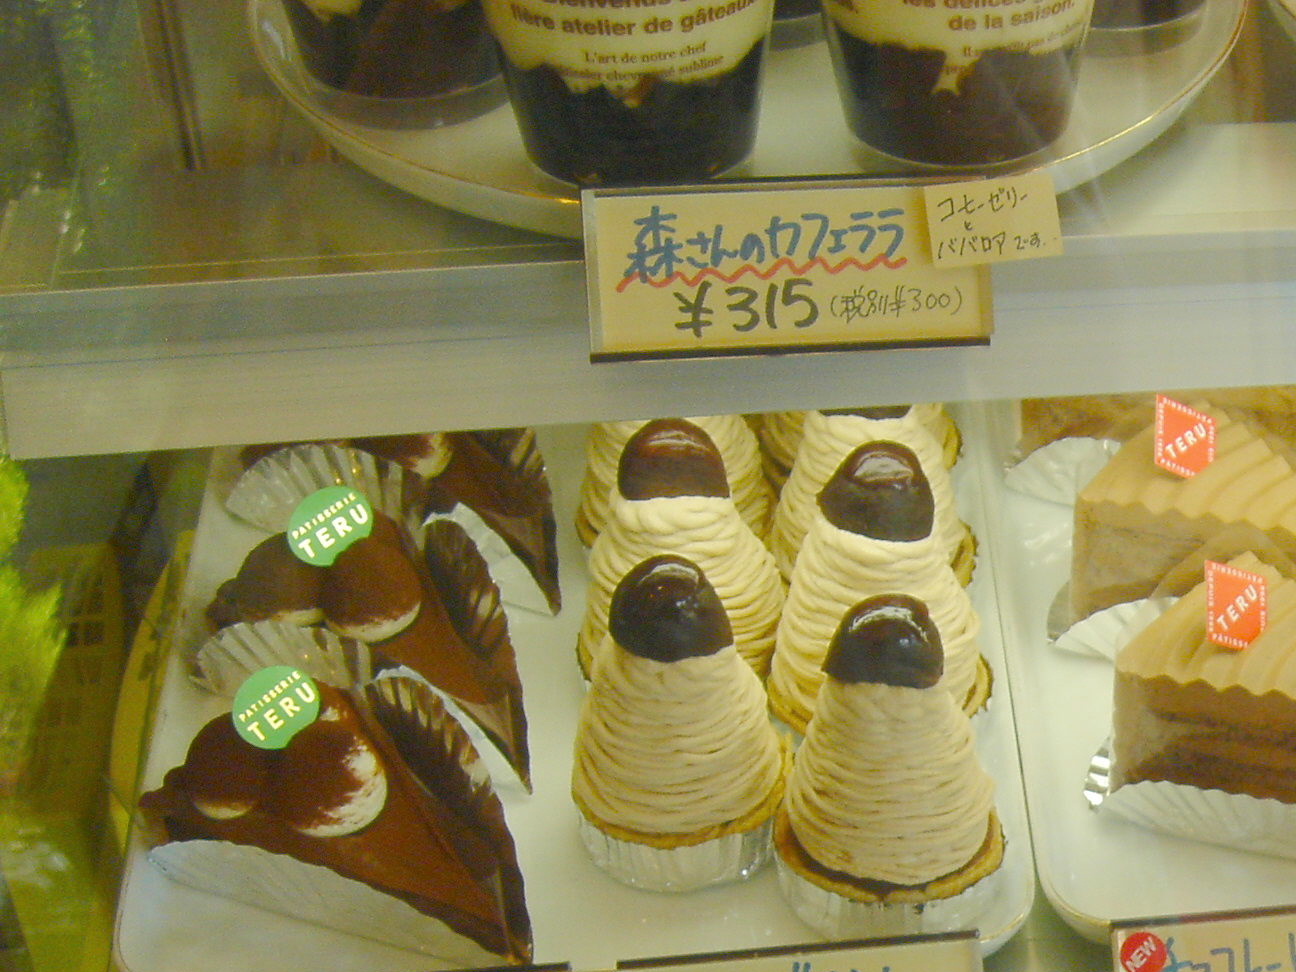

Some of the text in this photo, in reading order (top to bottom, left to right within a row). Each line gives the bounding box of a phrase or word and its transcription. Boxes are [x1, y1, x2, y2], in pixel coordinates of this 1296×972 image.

[562, 18, 637, 36] atelier
[644, 16, 673, 34] de
[947, 15, 977, 31] de
[984, 14, 1003, 29] la
[673, 278, 819, 338] ¥315
[1165, 422, 1207, 459] TERU
[291, 492, 357, 540] PATISSERIE
[298, 503, 369, 559] TERU
[1217, 584, 1258, 630] TERU
[238, 670, 301, 723] PATISSERIE
[247, 682, 316, 742] TERU
